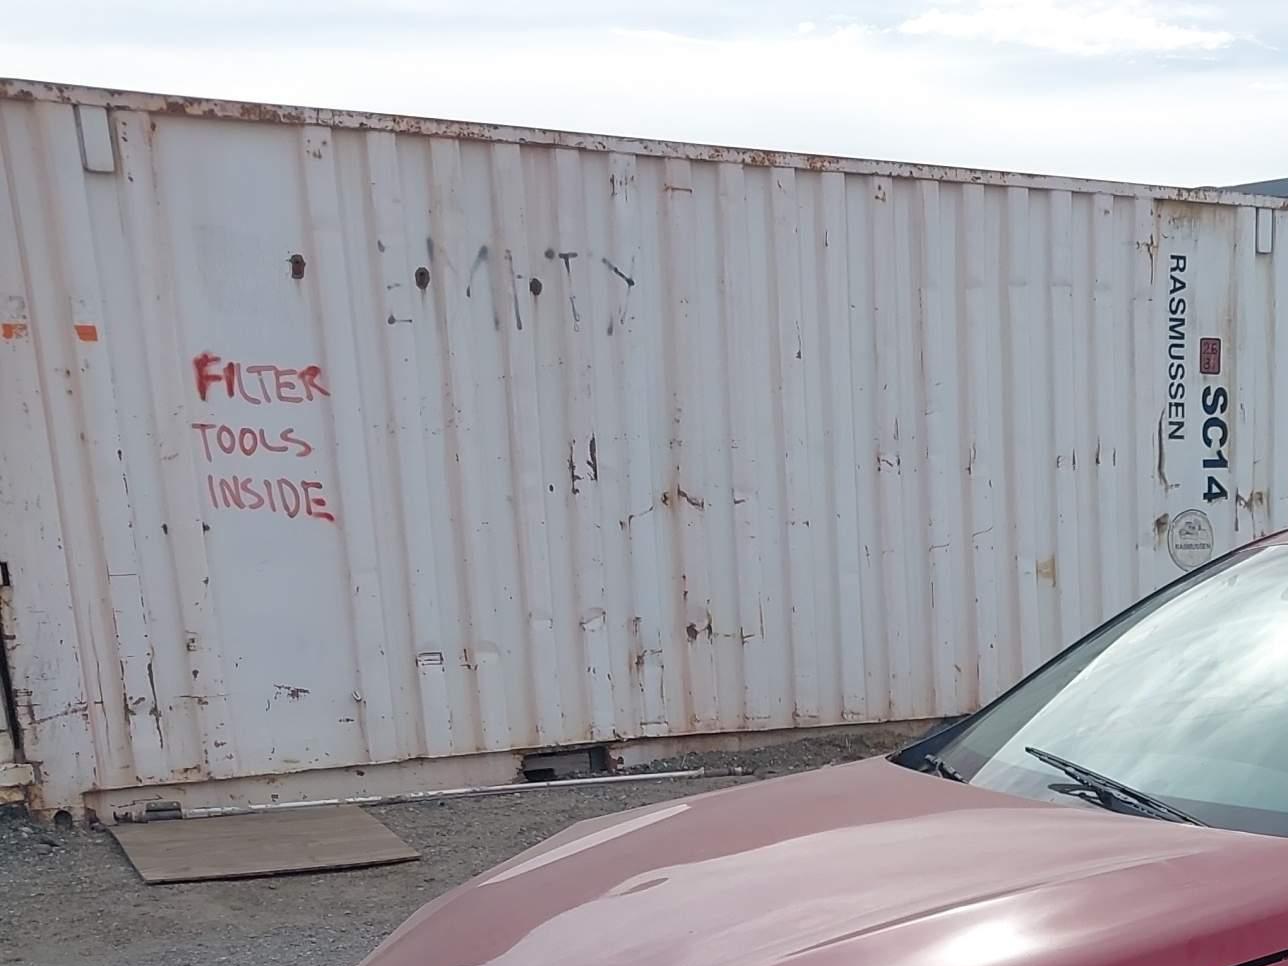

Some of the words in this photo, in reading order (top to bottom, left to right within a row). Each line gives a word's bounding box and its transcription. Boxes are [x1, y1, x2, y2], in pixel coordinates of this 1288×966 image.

[1168, 254, 1187, 440] RASMUSSEN
[193, 353, 331, 405] FILTER
[191, 423, 313, 463] TOOLS
[1202, 385, 1228, 502] SC14
[207, 474, 334, 522] INSIDE
